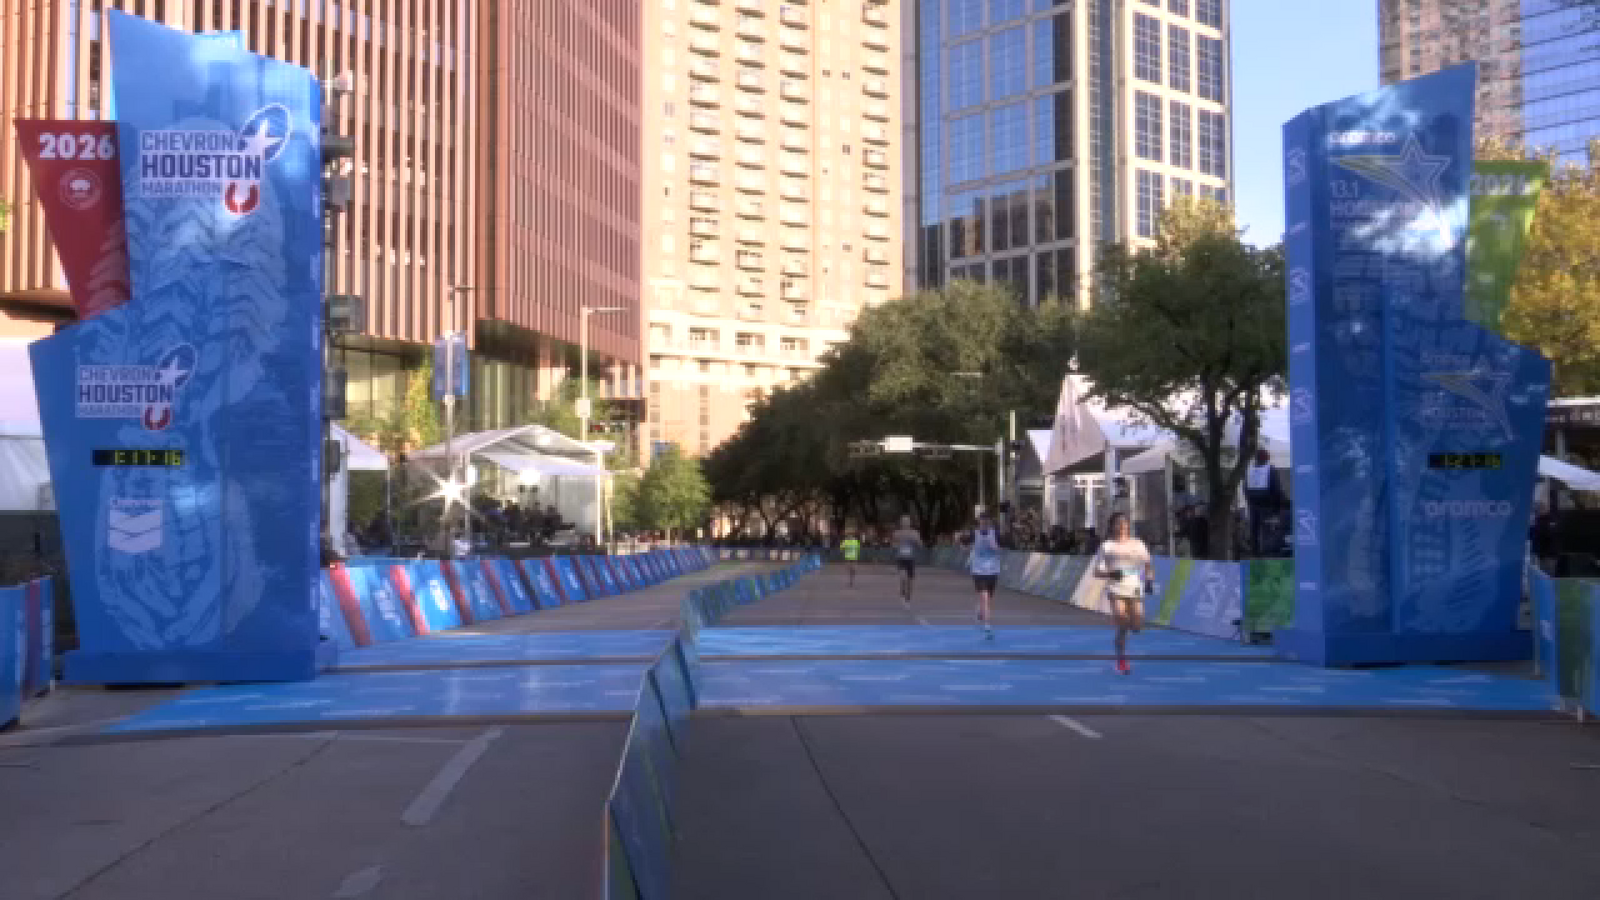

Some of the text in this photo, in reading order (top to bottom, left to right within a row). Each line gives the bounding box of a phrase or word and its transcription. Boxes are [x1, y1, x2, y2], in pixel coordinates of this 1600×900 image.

[38, 133, 116, 161] 2026
[141, 131, 234, 151] CHEVRON
[142, 154, 262, 179] HOUSTON
[141, 182, 222, 197] MARATHON
[1330, 180, 1358, 198] 13.1
[79, 367, 153, 381] CHEVRON
[79, 384, 173, 404] HOUSTON
[1424, 500, 1513, 516] aramco
